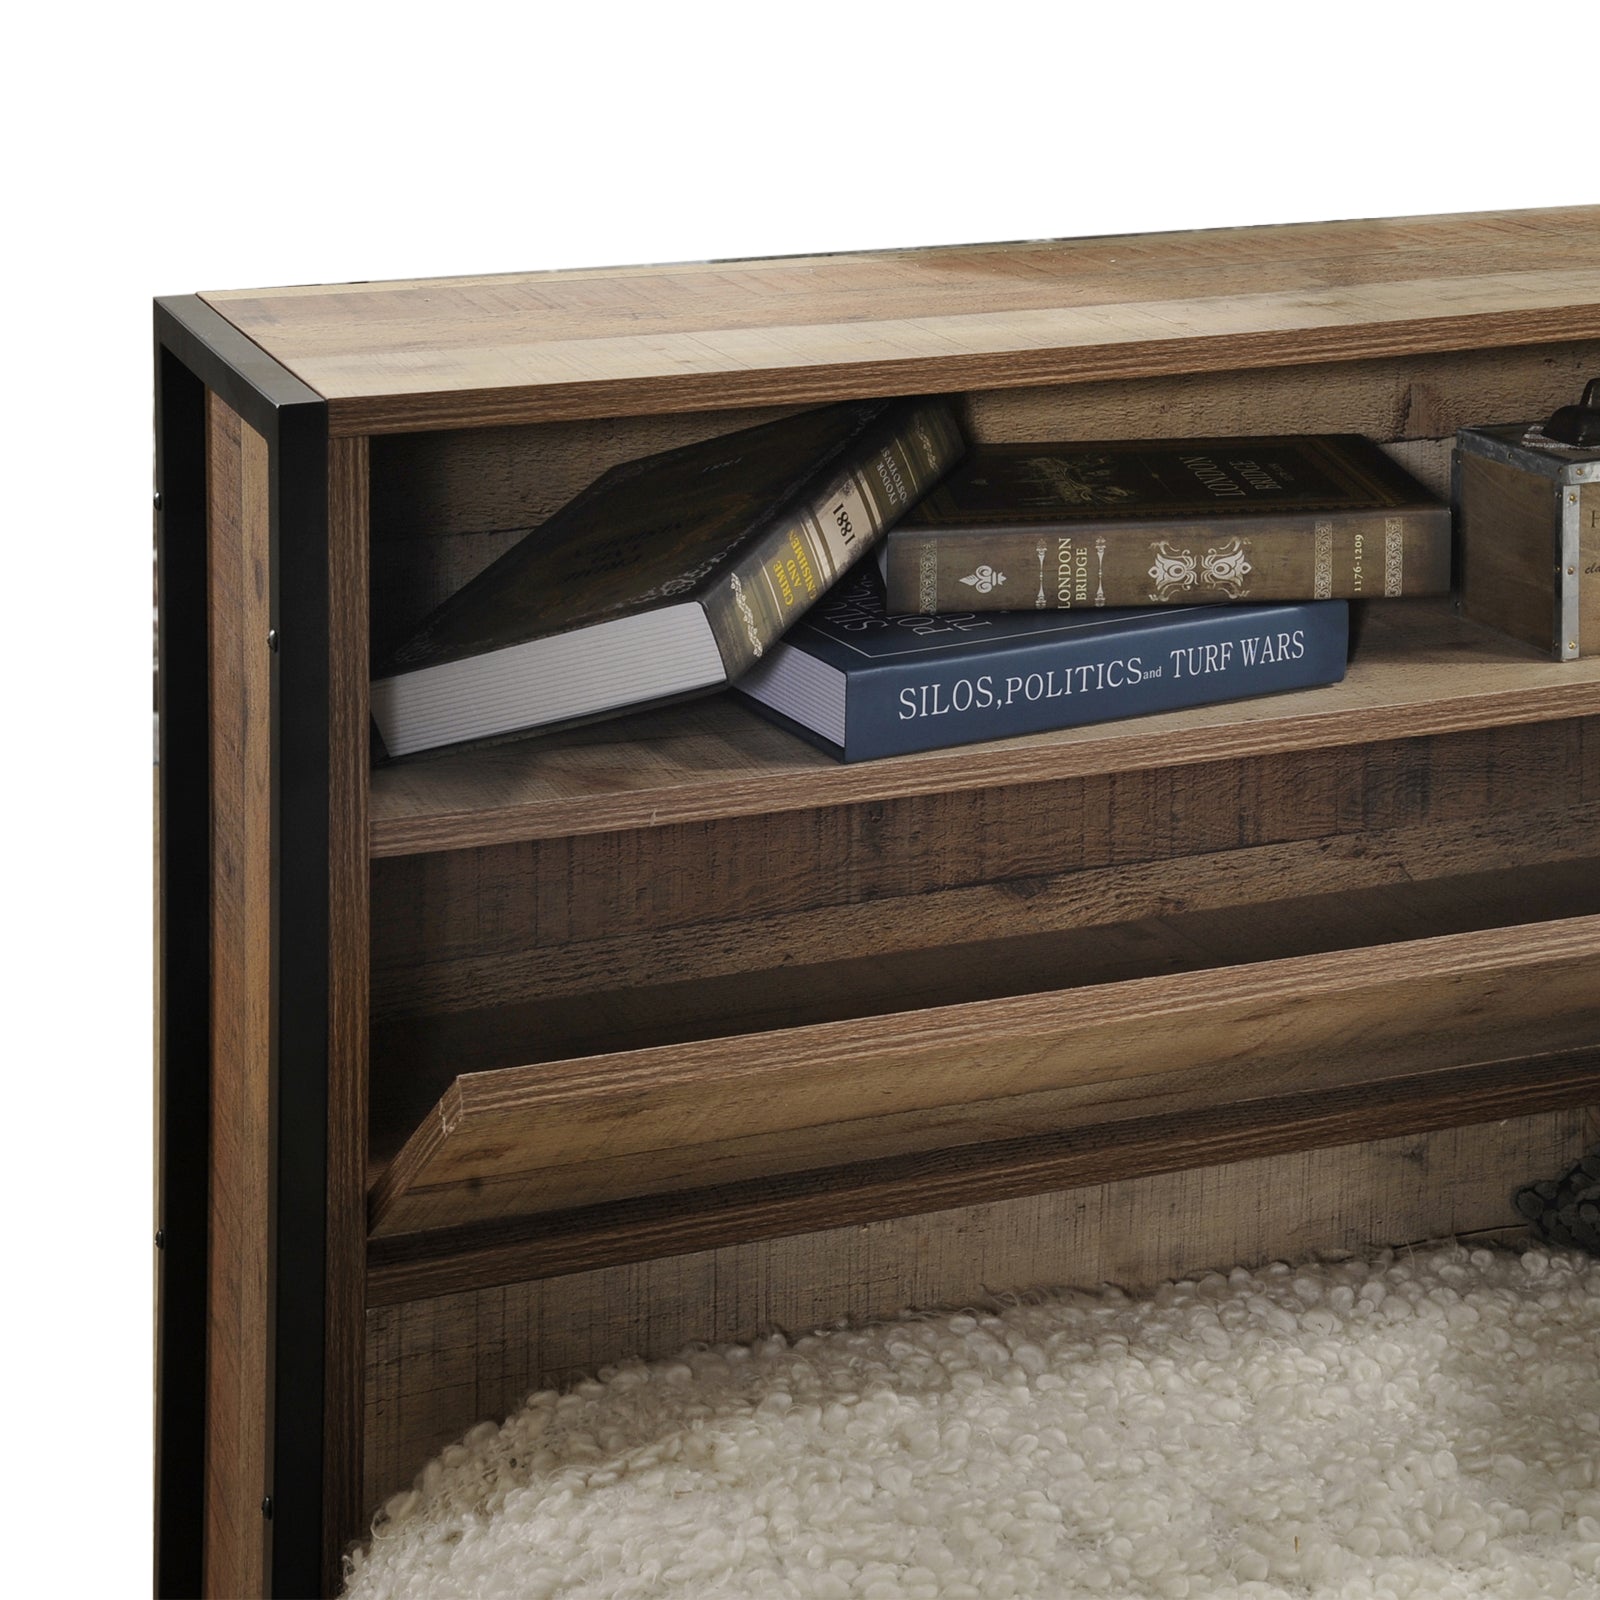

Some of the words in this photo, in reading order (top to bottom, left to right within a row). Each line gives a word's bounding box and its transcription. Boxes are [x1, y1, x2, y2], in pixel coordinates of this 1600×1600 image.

[876, 462, 897, 505] FYODOR
[1179, 457, 1246, 496] LONDON
[832, 503, 856, 546] 1881
[773, 560, 794, 606] CRIME
[786, 559, 802, 588] AND
[1057, 537, 1072, 609] LONDON
[1075, 547, 1088, 601] BRIDGE
[1352, 534, 1364, 592] 1176-1209
[1142, 666, 1162, 680] and
[1170, 642, 1233, 678] TURF
[1240, 630, 1305, 667] WARS
